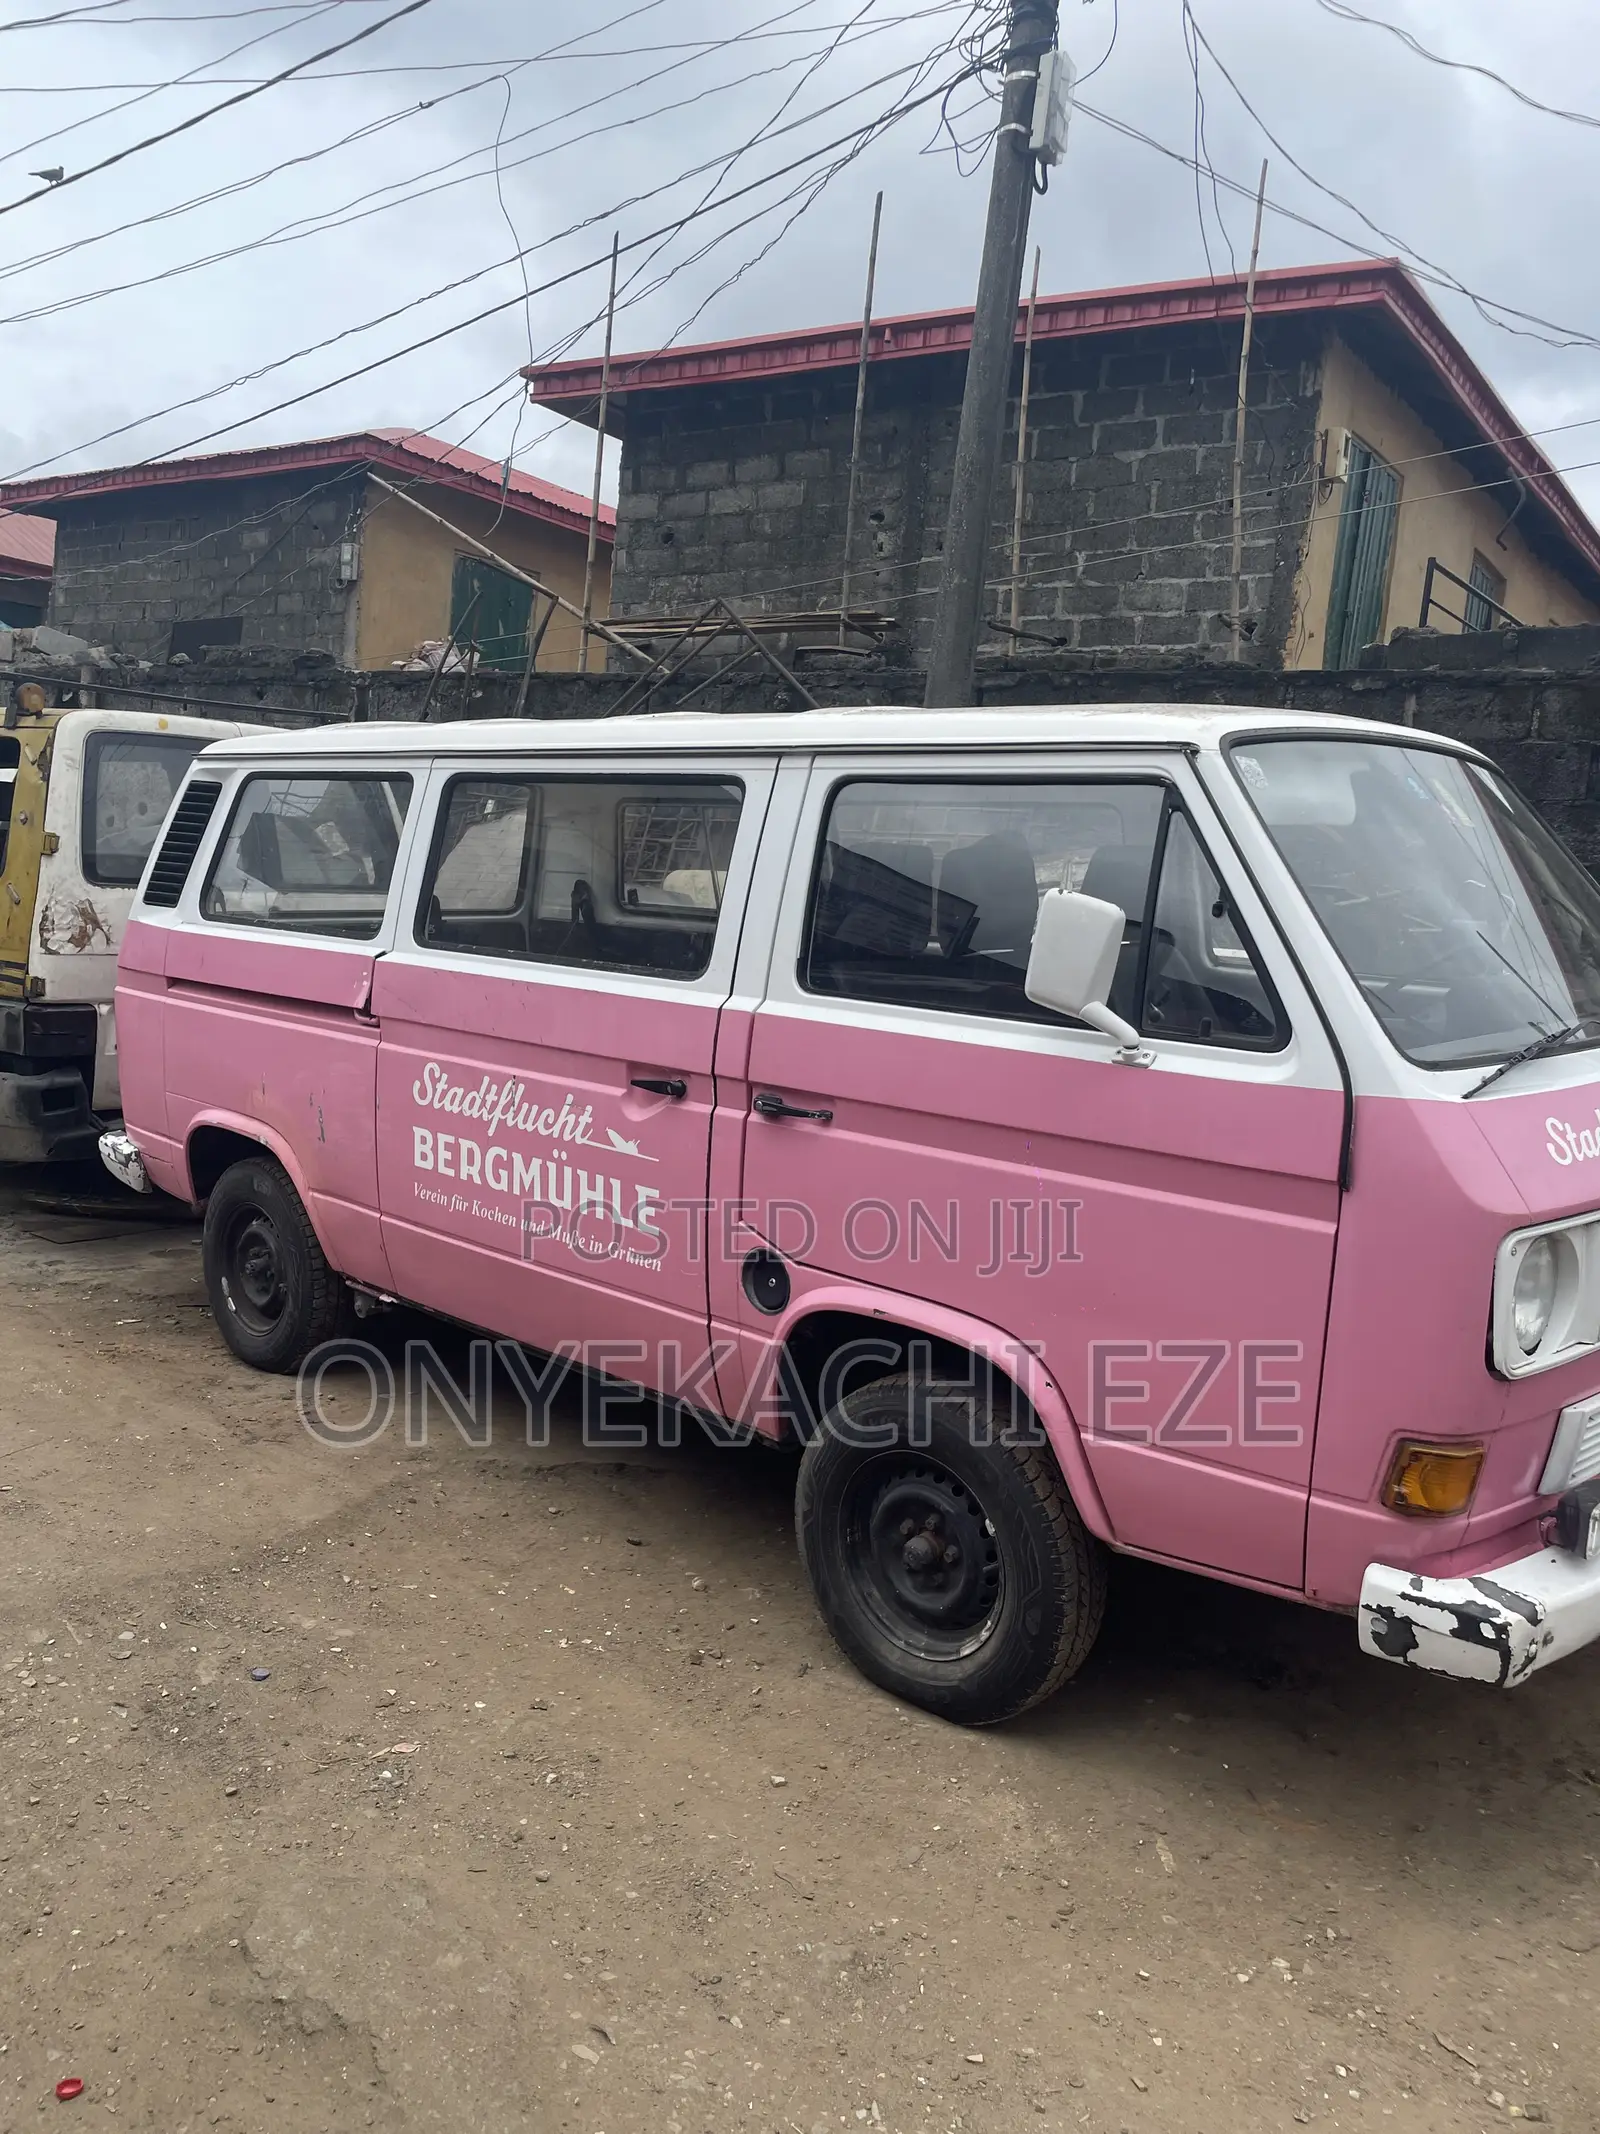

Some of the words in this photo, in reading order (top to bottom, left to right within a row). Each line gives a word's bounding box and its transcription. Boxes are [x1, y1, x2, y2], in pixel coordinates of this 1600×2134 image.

[412, 1062, 593, 1145] Stadtflucht
[412, 1126, 660, 1236] BERGMÜHLE
[413, 1182, 448, 1206] Verein
[449, 1194, 469, 1212] für
[471, 1200, 516, 1227] Kochen
[520, 1218, 545, 1236] und
[548, 1223, 586, 1249] Muße
[589, 1235, 603, 1253] in
[607, 1241, 662, 1272] Grünen
